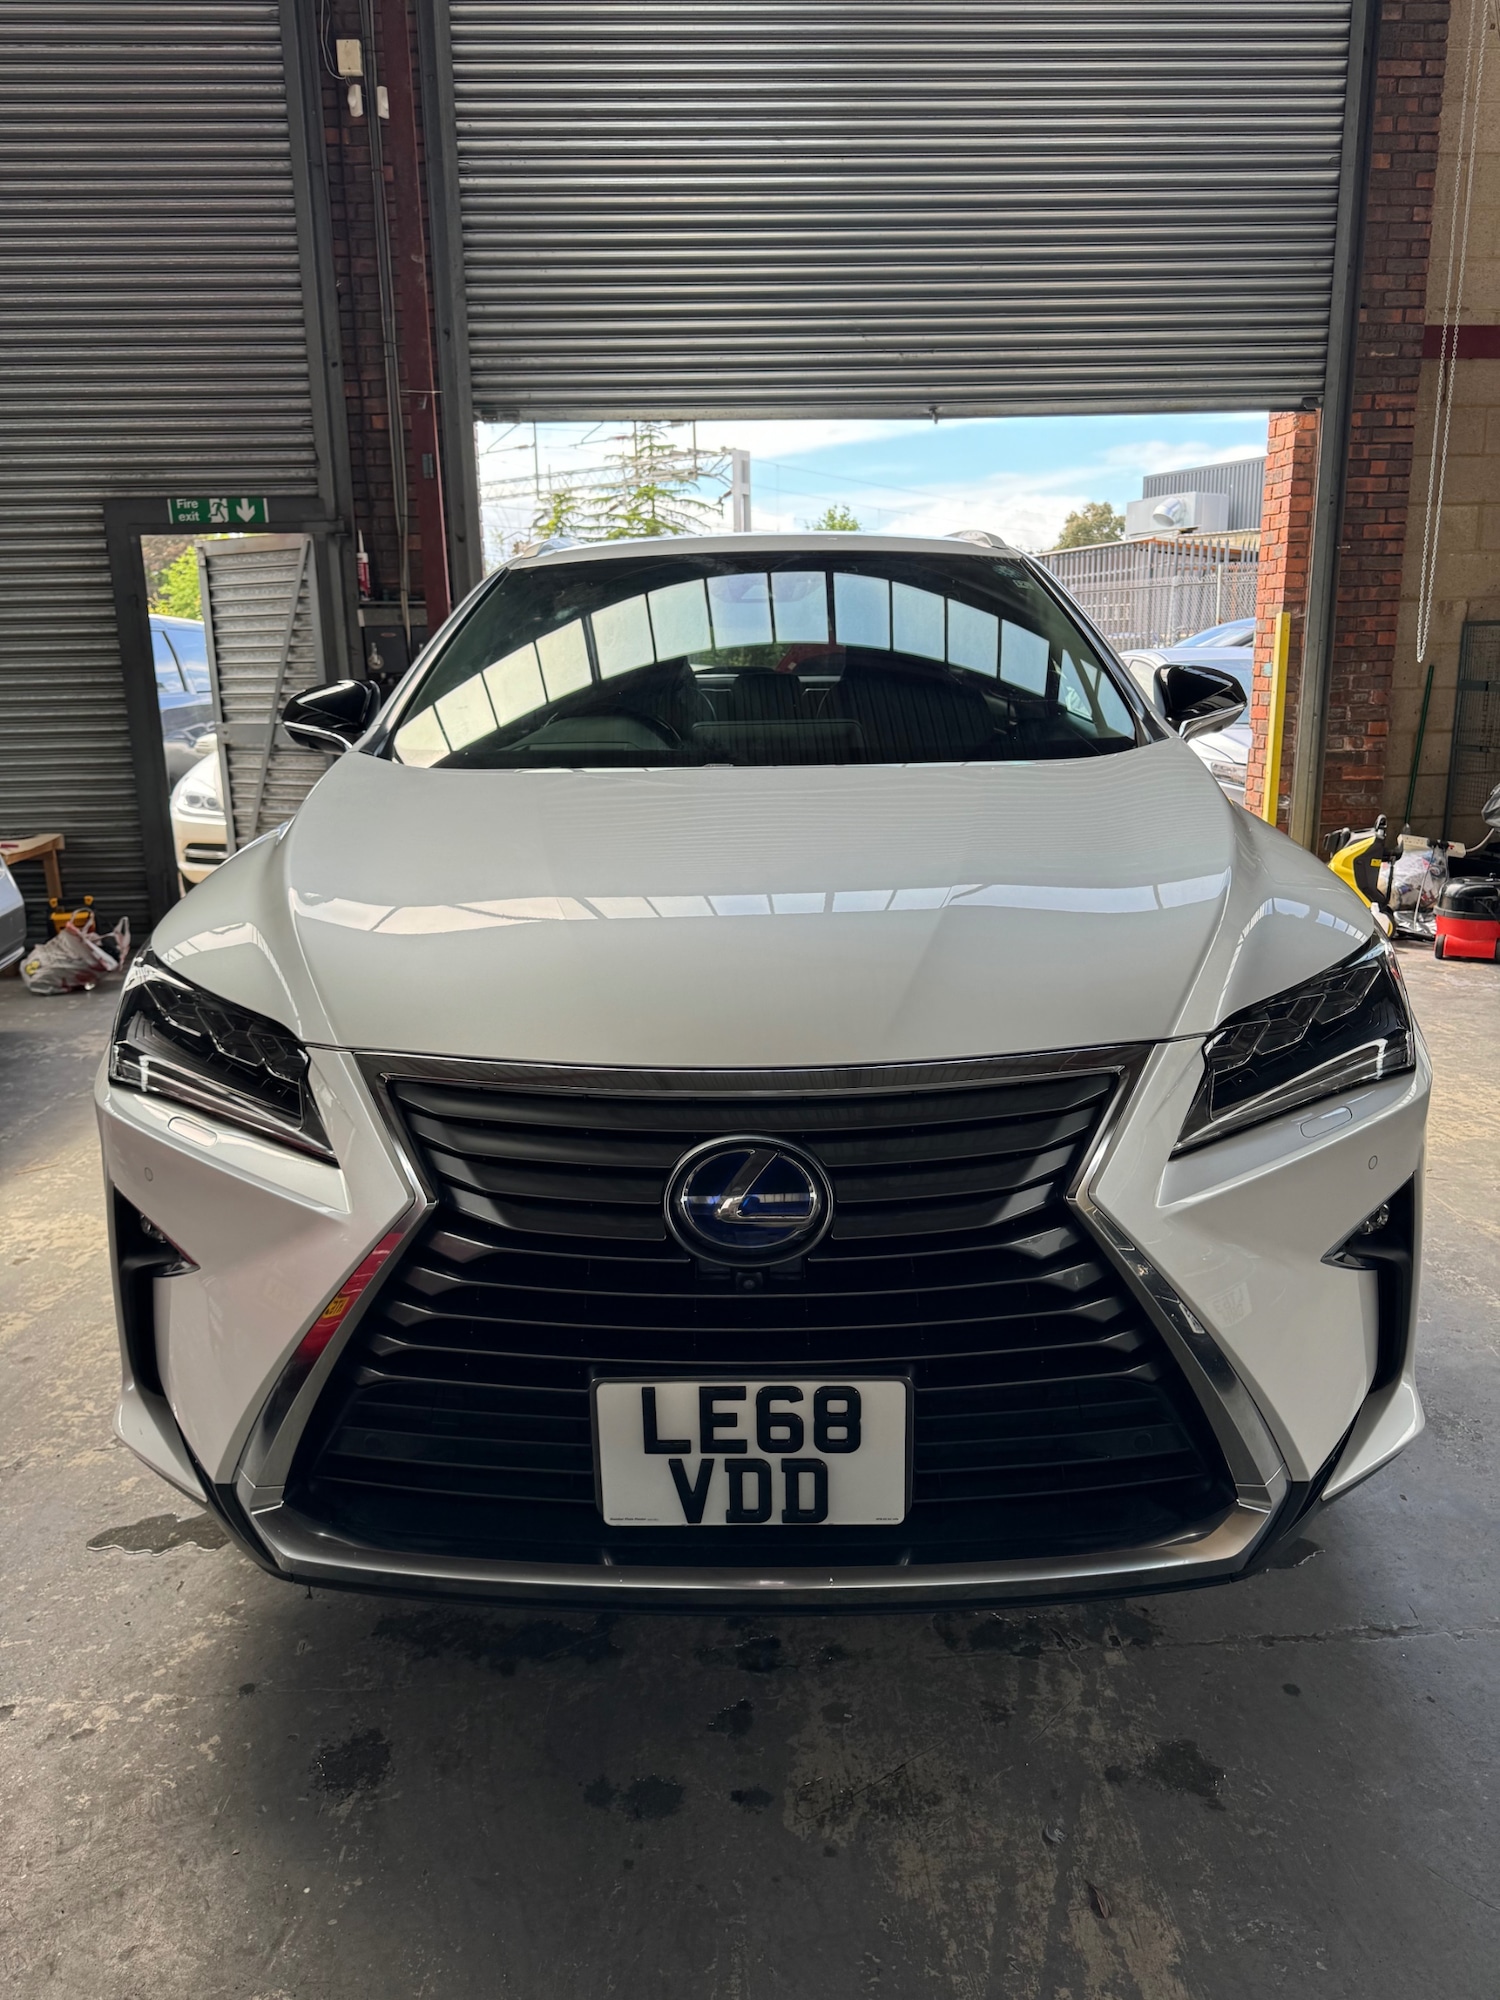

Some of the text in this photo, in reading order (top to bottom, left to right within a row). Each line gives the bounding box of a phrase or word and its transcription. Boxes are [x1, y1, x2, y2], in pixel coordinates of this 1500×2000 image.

[176, 498, 199, 509] Fire
[178, 511, 200, 522] exit
[641, 1385, 862, 1454] LE68
[668, 1458, 829, 1524] VDD
